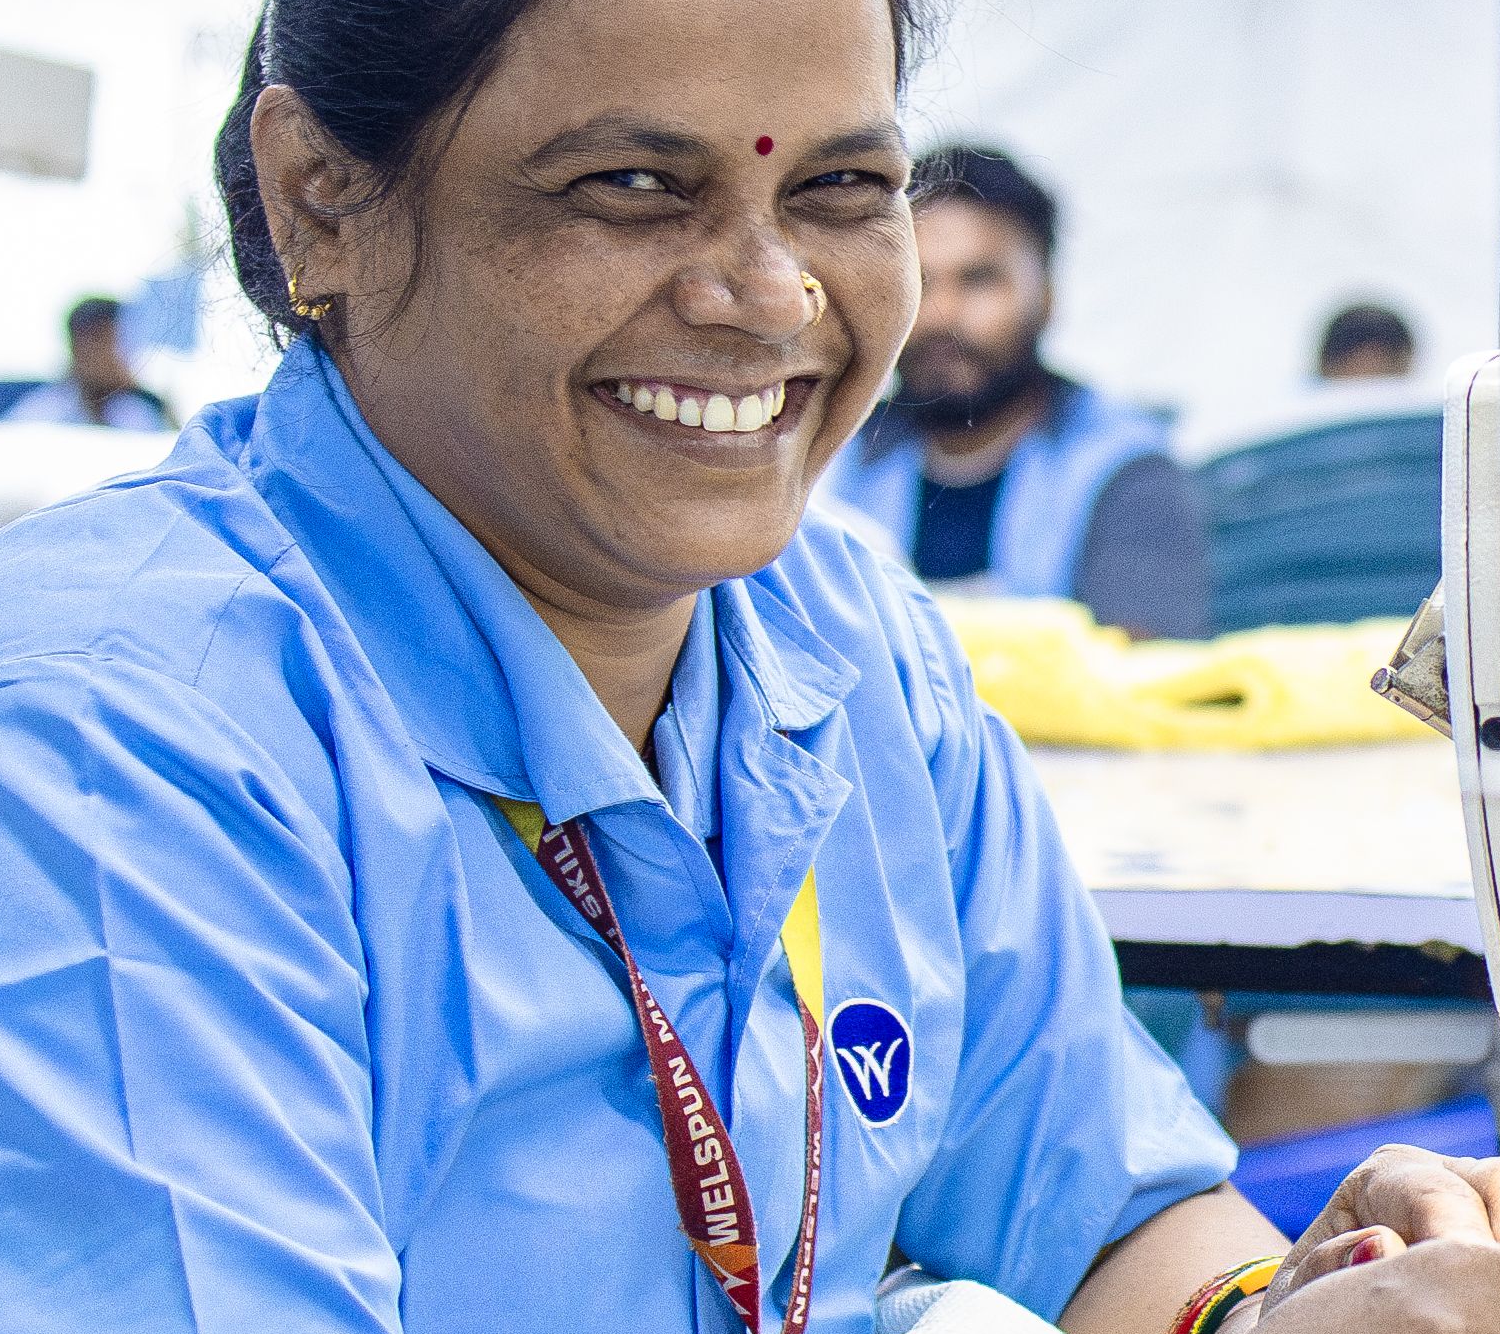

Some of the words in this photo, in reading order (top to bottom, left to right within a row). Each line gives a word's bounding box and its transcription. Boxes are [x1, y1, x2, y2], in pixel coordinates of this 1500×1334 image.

[668, 1056, 740, 1249] WELSPUN
[836, 1037, 904, 1101] W
[791, 1131, 822, 1326] WELSPUN
